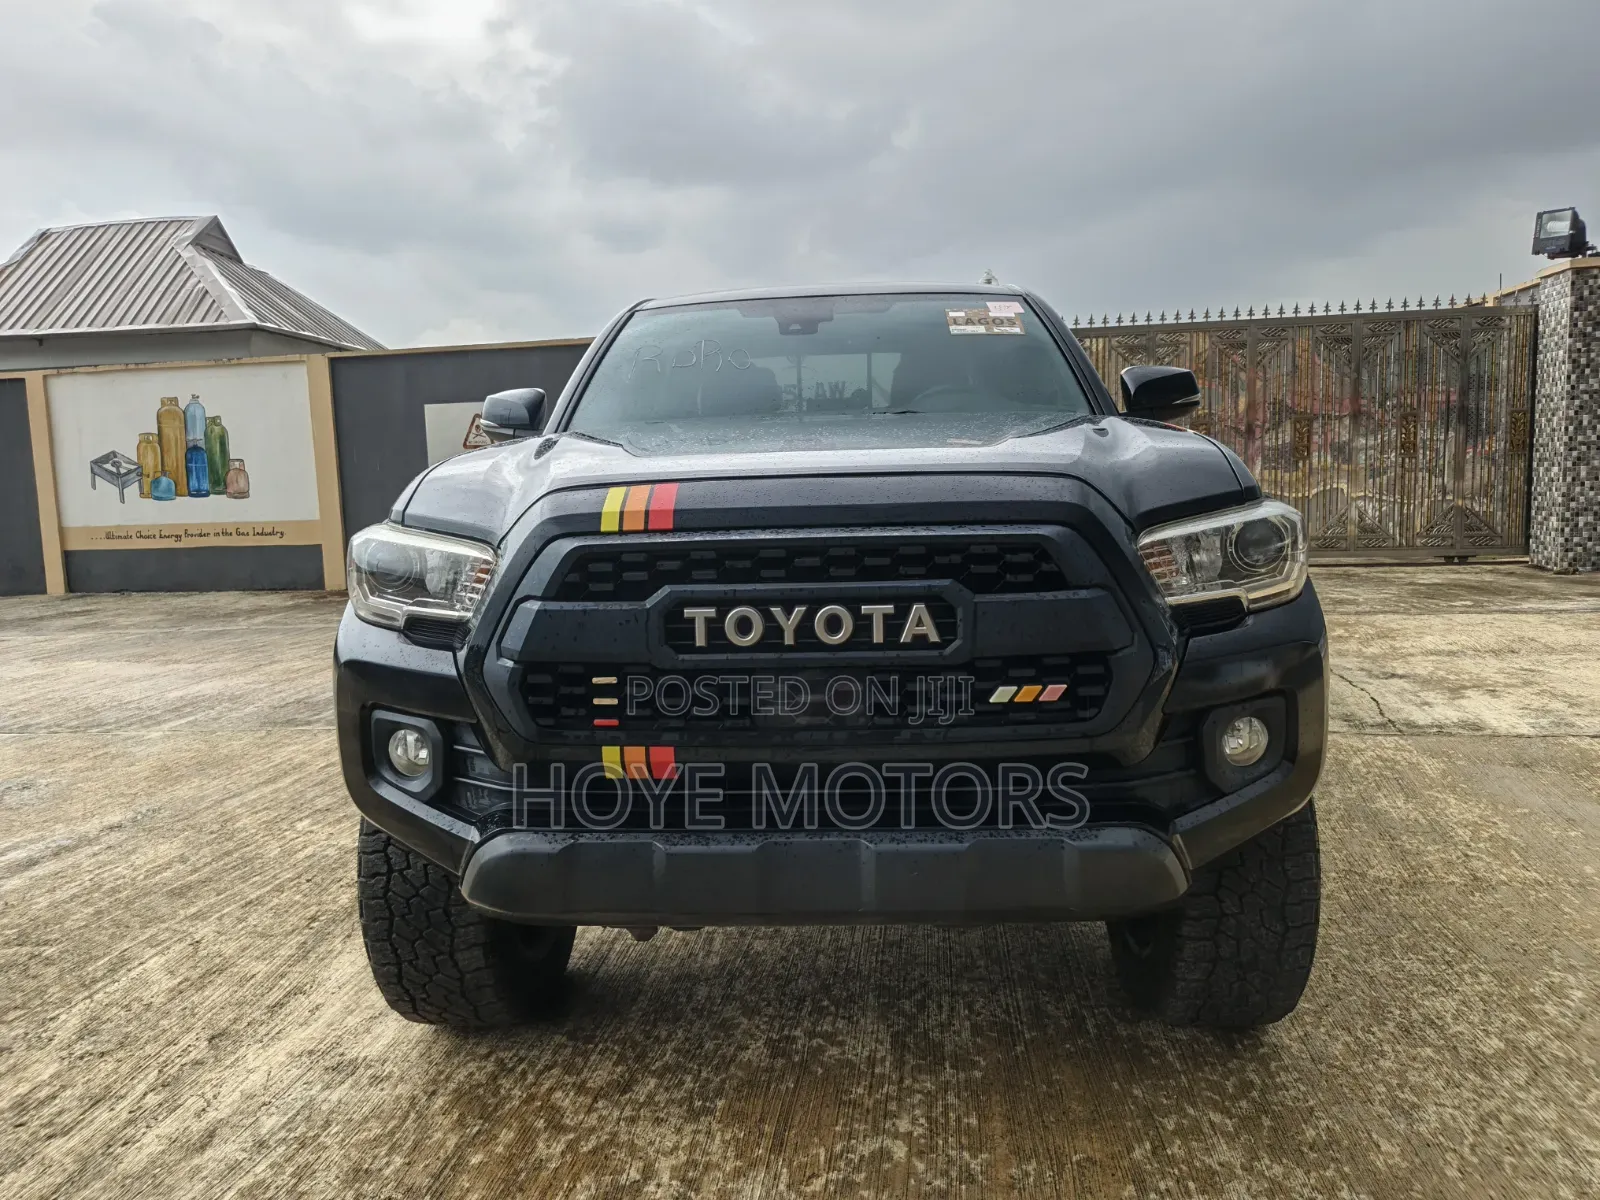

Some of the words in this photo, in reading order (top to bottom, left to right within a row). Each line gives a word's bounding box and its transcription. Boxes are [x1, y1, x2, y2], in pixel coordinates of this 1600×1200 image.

[952, 317, 1017, 326] LAGOS
[135, 529, 157, 540] Choice
[159, 529, 182, 543] Energy
[184, 528, 211, 539] Provider
[221, 527, 233, 537] the
[235, 527, 250, 537] Gas
[683, 603, 942, 648] TOYOTA
